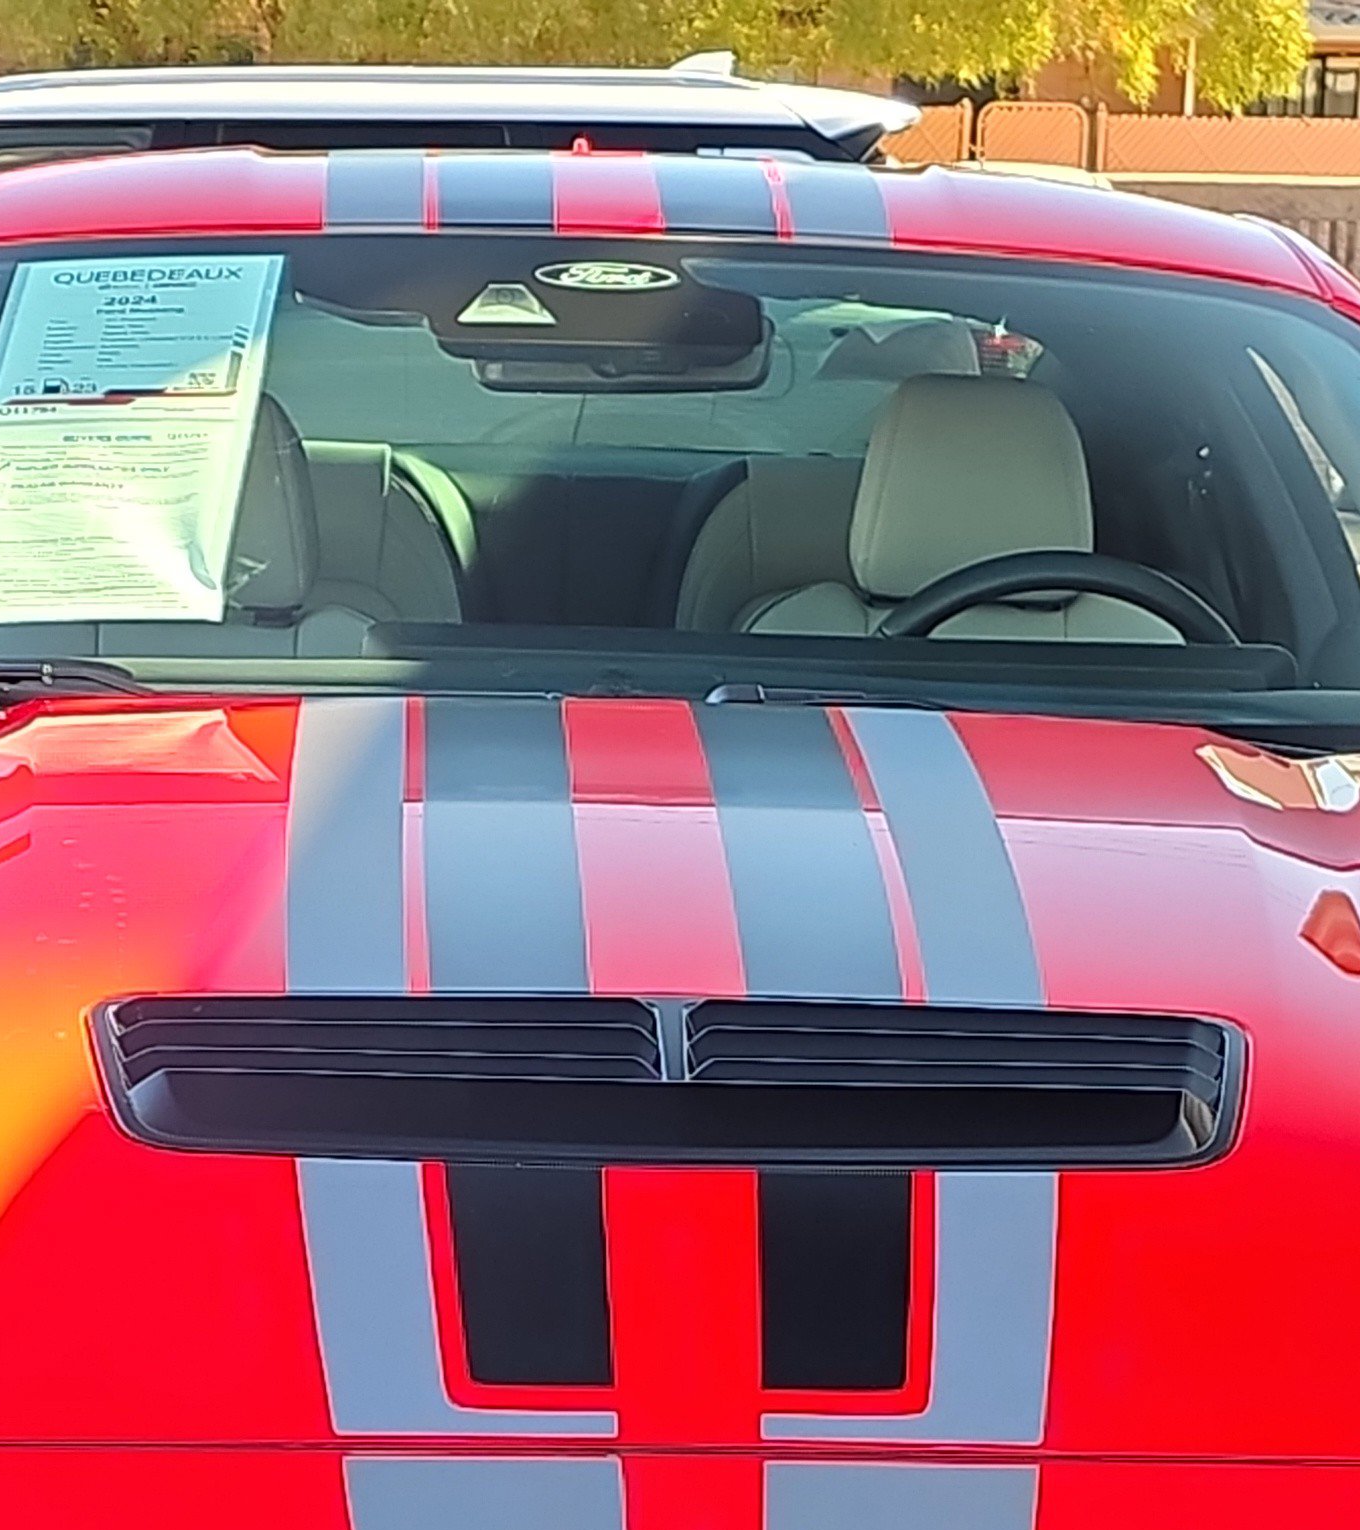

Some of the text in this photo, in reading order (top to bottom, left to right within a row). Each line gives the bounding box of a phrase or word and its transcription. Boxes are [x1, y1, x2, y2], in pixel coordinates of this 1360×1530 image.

[53, 266, 244, 285] QUEBEDEAUX
[558, 265, 653, 286] Ford
[103, 295, 159, 306] 2024
